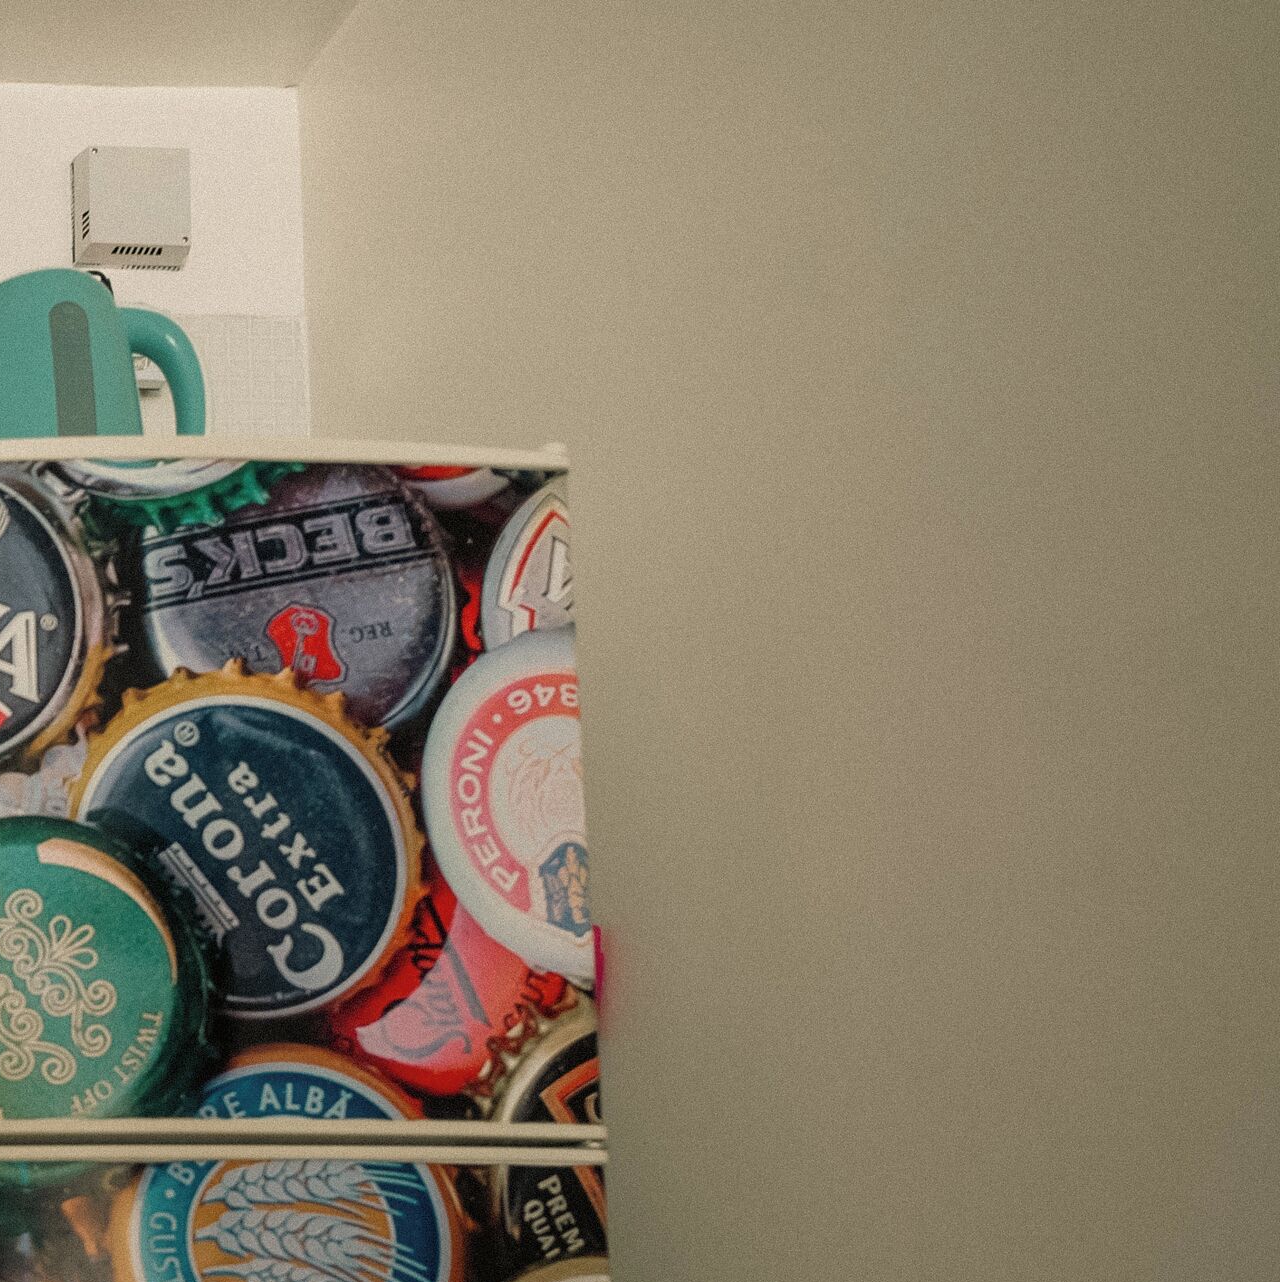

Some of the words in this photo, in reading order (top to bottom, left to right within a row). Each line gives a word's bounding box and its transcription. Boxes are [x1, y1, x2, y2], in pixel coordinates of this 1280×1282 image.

[227, 761, 345, 912] Extra
[458, 728, 520, 892] PERONI
[507, 683, 578, 715] 846
[144, 740, 345, 991] Corona
[113, 1010, 164, 1085] TWIST
[537, 1174, 585, 1252] PREM
